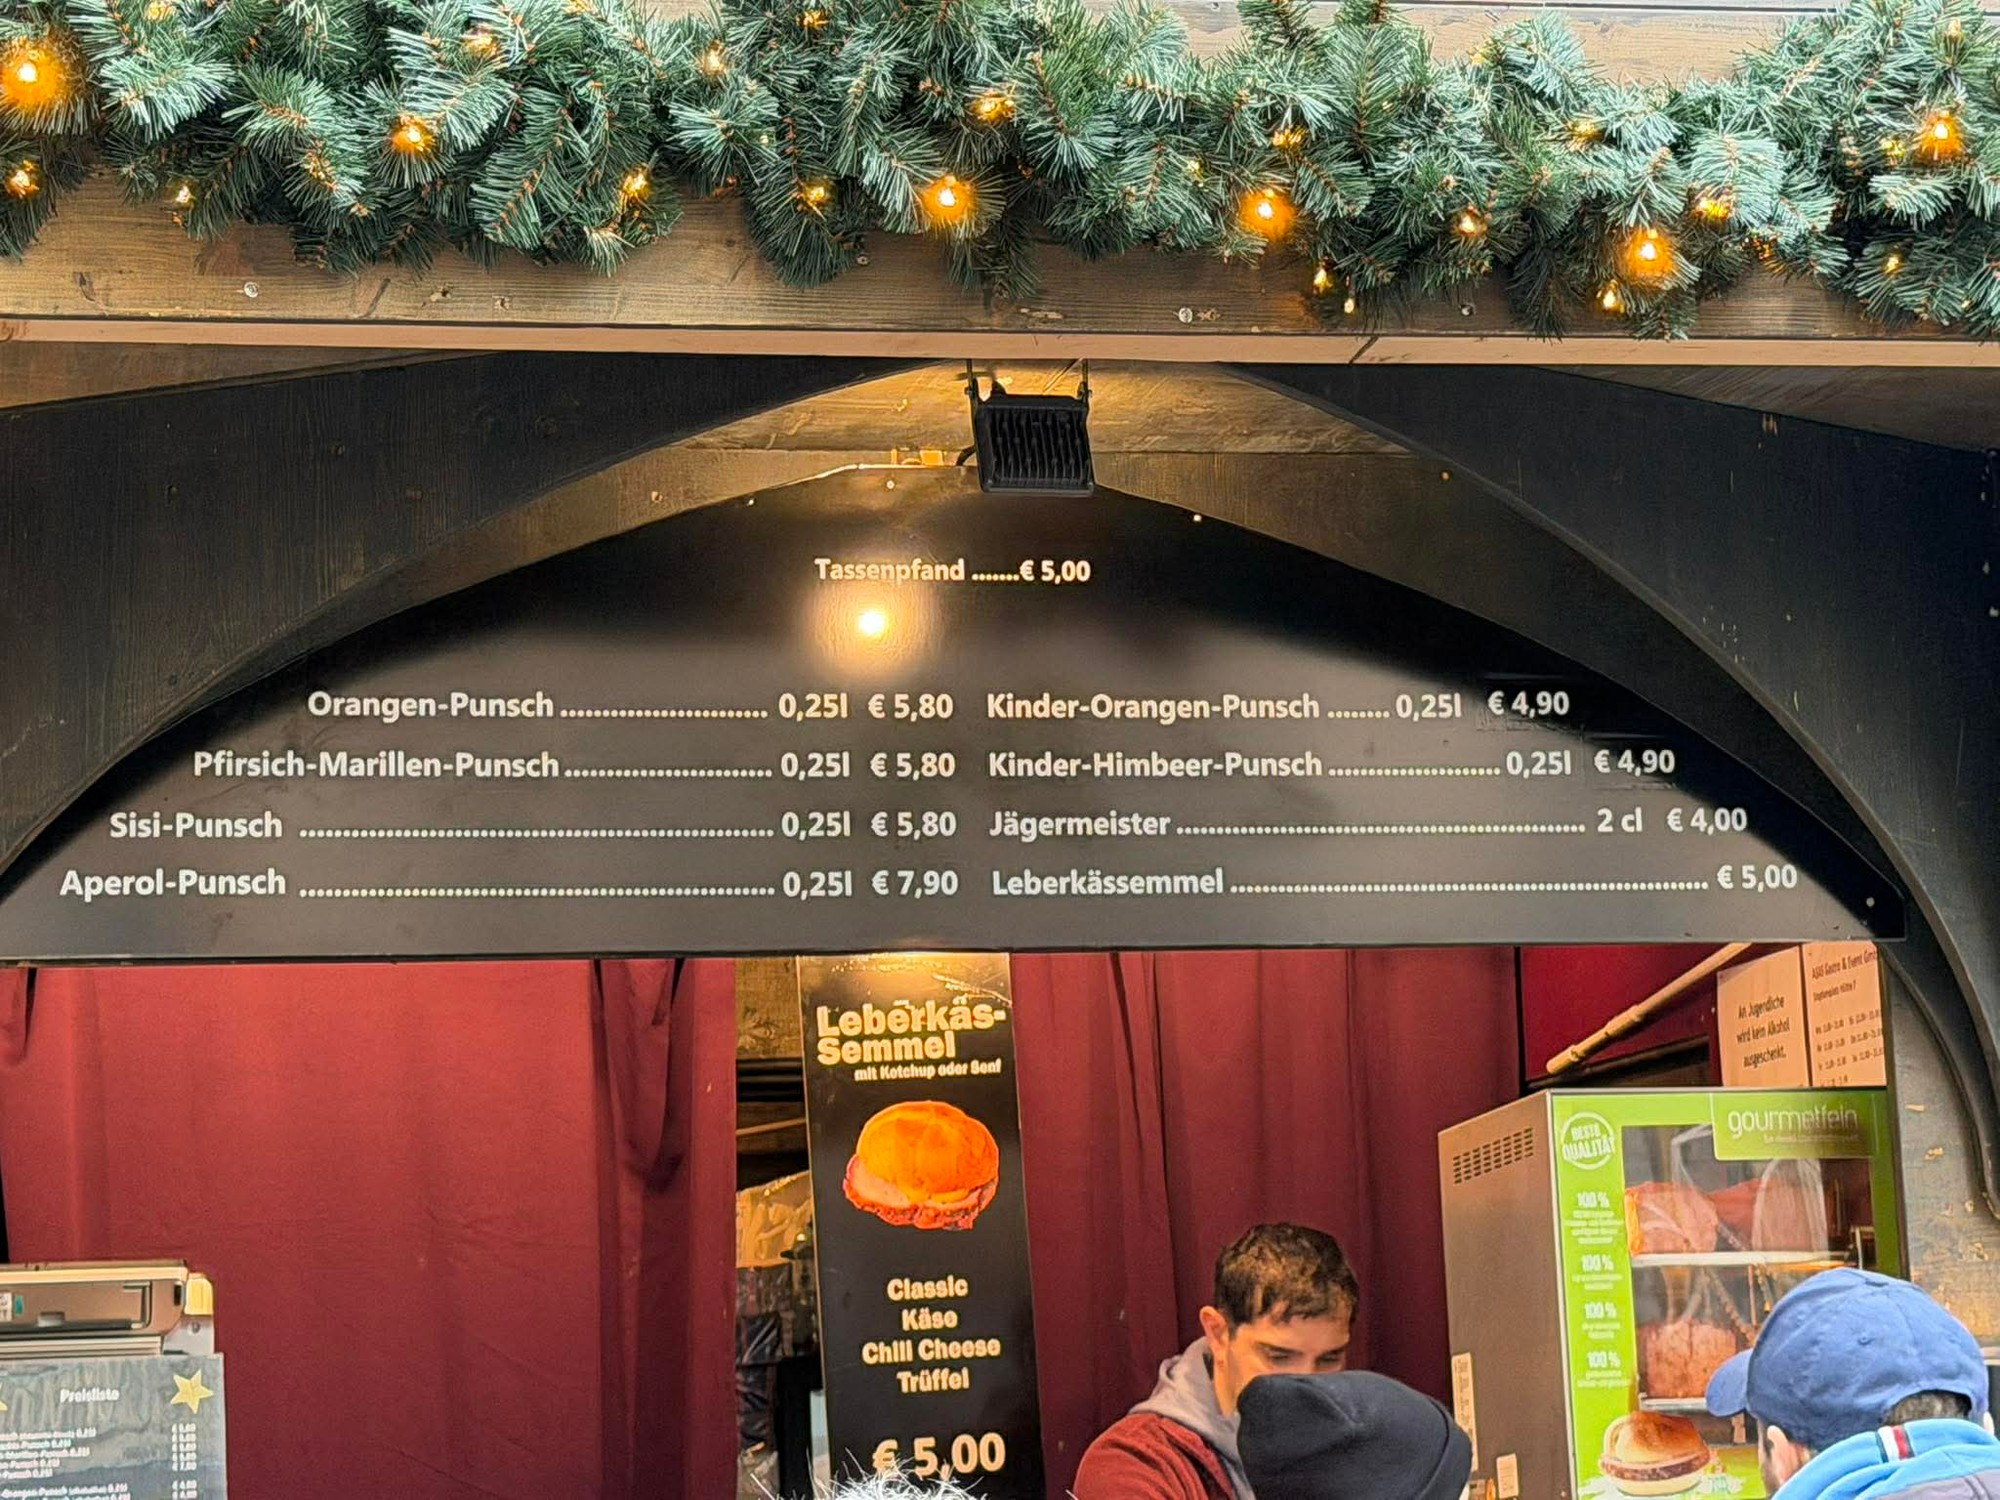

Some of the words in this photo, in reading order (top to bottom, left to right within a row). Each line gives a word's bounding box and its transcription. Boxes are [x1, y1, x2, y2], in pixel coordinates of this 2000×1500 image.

[814, 557, 966, 585] Tassenpfand
[1019, 559, 1036, 582] €
[1040, 559, 1092, 585] 5,00
[307, 690, 554, 724] Orangen-Punsch
[778, 693, 849, 722] 0,25l
[868, 693, 886, 719] €
[893, 693, 954, 722] 5,80
[987, 692, 1321, 725] Kinder-Orangen-Punsch
[1395, 693, 1462, 722] 0,25l
[1487, 690, 1505, 716] €
[1511, 690, 1570, 718] 4,90
[193, 750, 560, 778] Pfirsich-Marillen-Punsch
[780, 751, 851, 781] 0,25l
[870, 751, 888, 777] €
[896, 751, 956, 781] 5,80
[988, 750, 1323, 778] Kinder-Himbeer-Punsch
[1505, 750, 1572, 779] 0,25l
[1593, 749, 1611, 774] €
[1617, 749, 1676, 777] 4,90
[109, 810, 283, 839] Sisi-Punsch
[781, 810, 851, 841] 0,25l
[871, 810, 889, 837] €
[896, 810, 957, 841] 5,80
[989, 809, 1172, 843] Jägermeister
[1597, 807, 1614, 833] 2
[1620, 806, 1643, 833] cl
[1666, 807, 1684, 832] €
[1690, 807, 1748, 836] 4,00
[59, 868, 286, 904] Aperol-Punsch
[782, 870, 853, 901] 0,25l
[871, 870, 890, 896] €
[896, 870, 959, 900] 7,90
[992, 866, 1225, 896] Leberkässemmel
[1716, 864, 1734, 890] €
[1741, 864, 1798, 893] 5,00
[816, 995, 1007, 1038] Leberkäs-
[817, 1031, 957, 1066] Semmel
[854, 1066, 878, 1082] mit
[880, 1062, 935, 1081] Ketchup
[938, 1060, 968, 1076] oder
[971, 1057, 1002, 1075] Senf
[1727, 1104, 1859, 1140] gourmetfein
[887, 1275, 969, 1302] Classic
[901, 1306, 959, 1332] Käse
[862, 1339, 914, 1365] Chili
[918, 1338, 1002, 1362] Cheese
[897, 1367, 970, 1394] Trüffel
[914, 1432, 1006, 1480] 5,00
